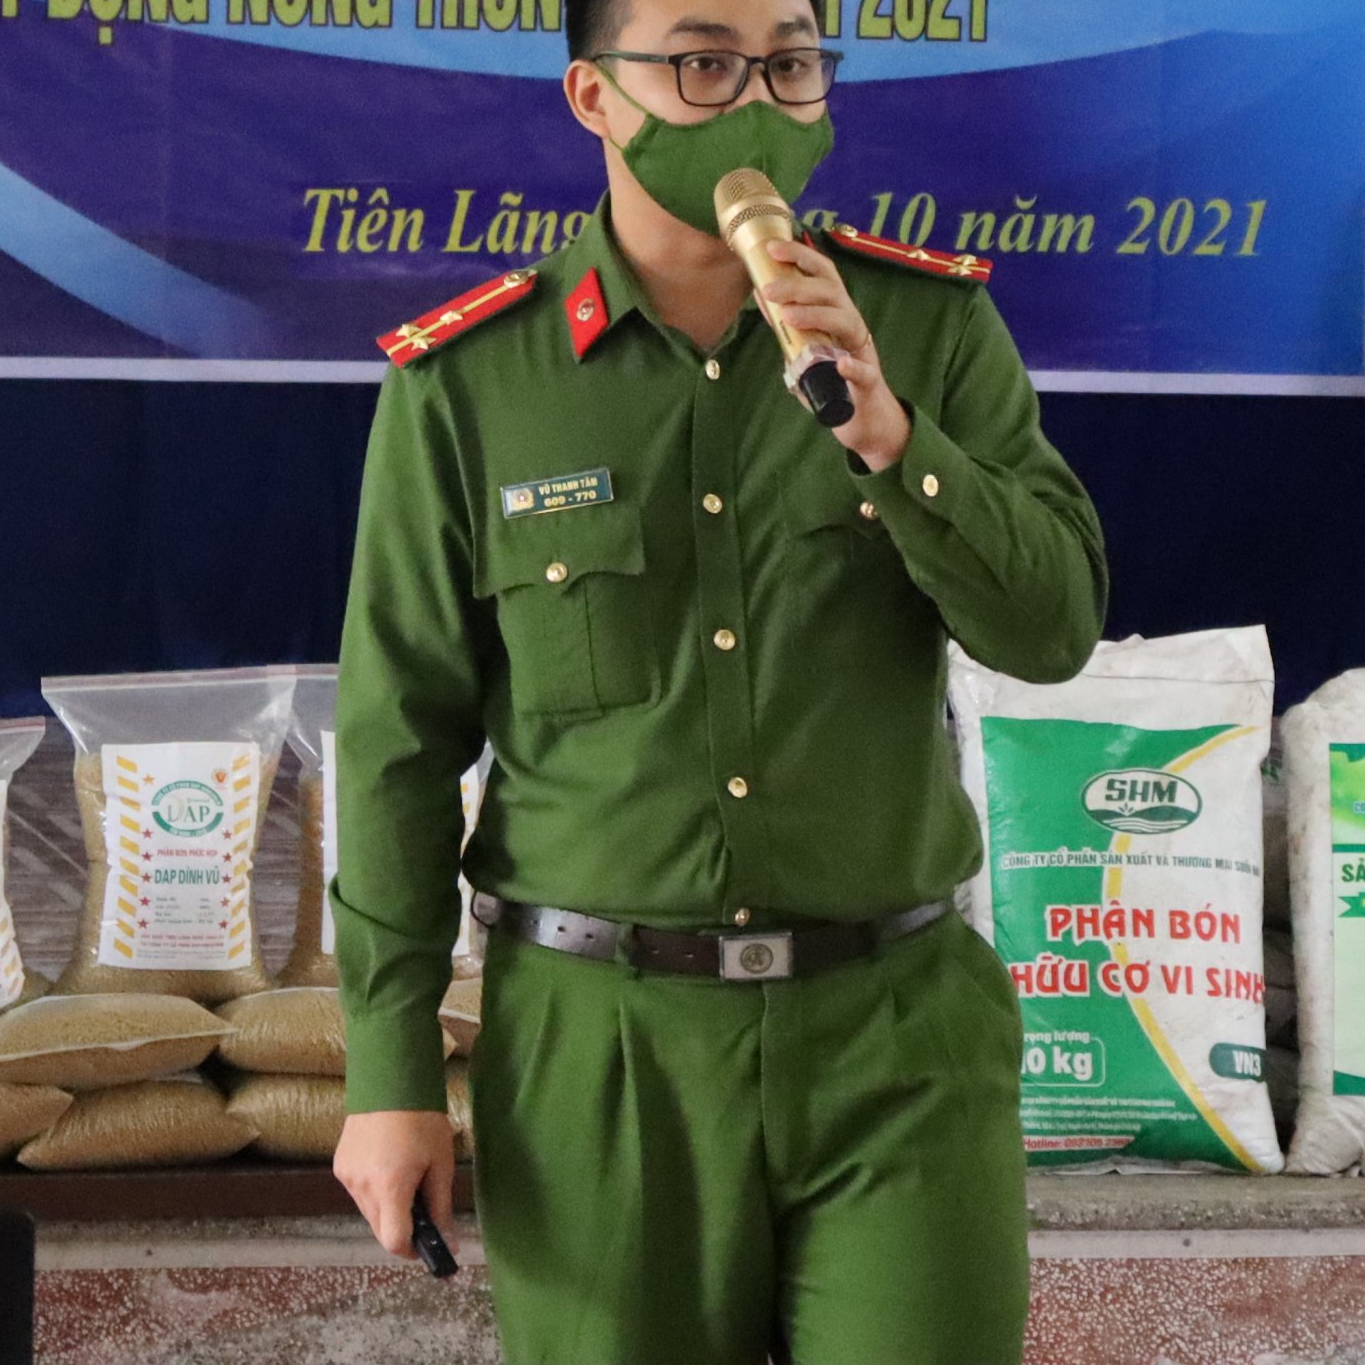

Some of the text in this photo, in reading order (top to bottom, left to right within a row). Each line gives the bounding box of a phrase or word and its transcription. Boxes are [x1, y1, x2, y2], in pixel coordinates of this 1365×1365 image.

[302, 188, 424, 253] Tiên
[872, 191, 937, 249] 10
[955, 194, 1094, 254] năm
[1116, 196, 1268, 258] 2021
[1104, 778, 1178, 804] SHM
[1034, 855, 1046, 866] TY
[154, 869, 176, 884] DAP
[1049, 899, 1241, 944] PHÂN BÓN
[1010, 955, 1265, 1004] HỮU CƠ VI SINH
[1053, 1046, 1093, 1081] kg
[1232, 1050, 1262, 1076] VN3
